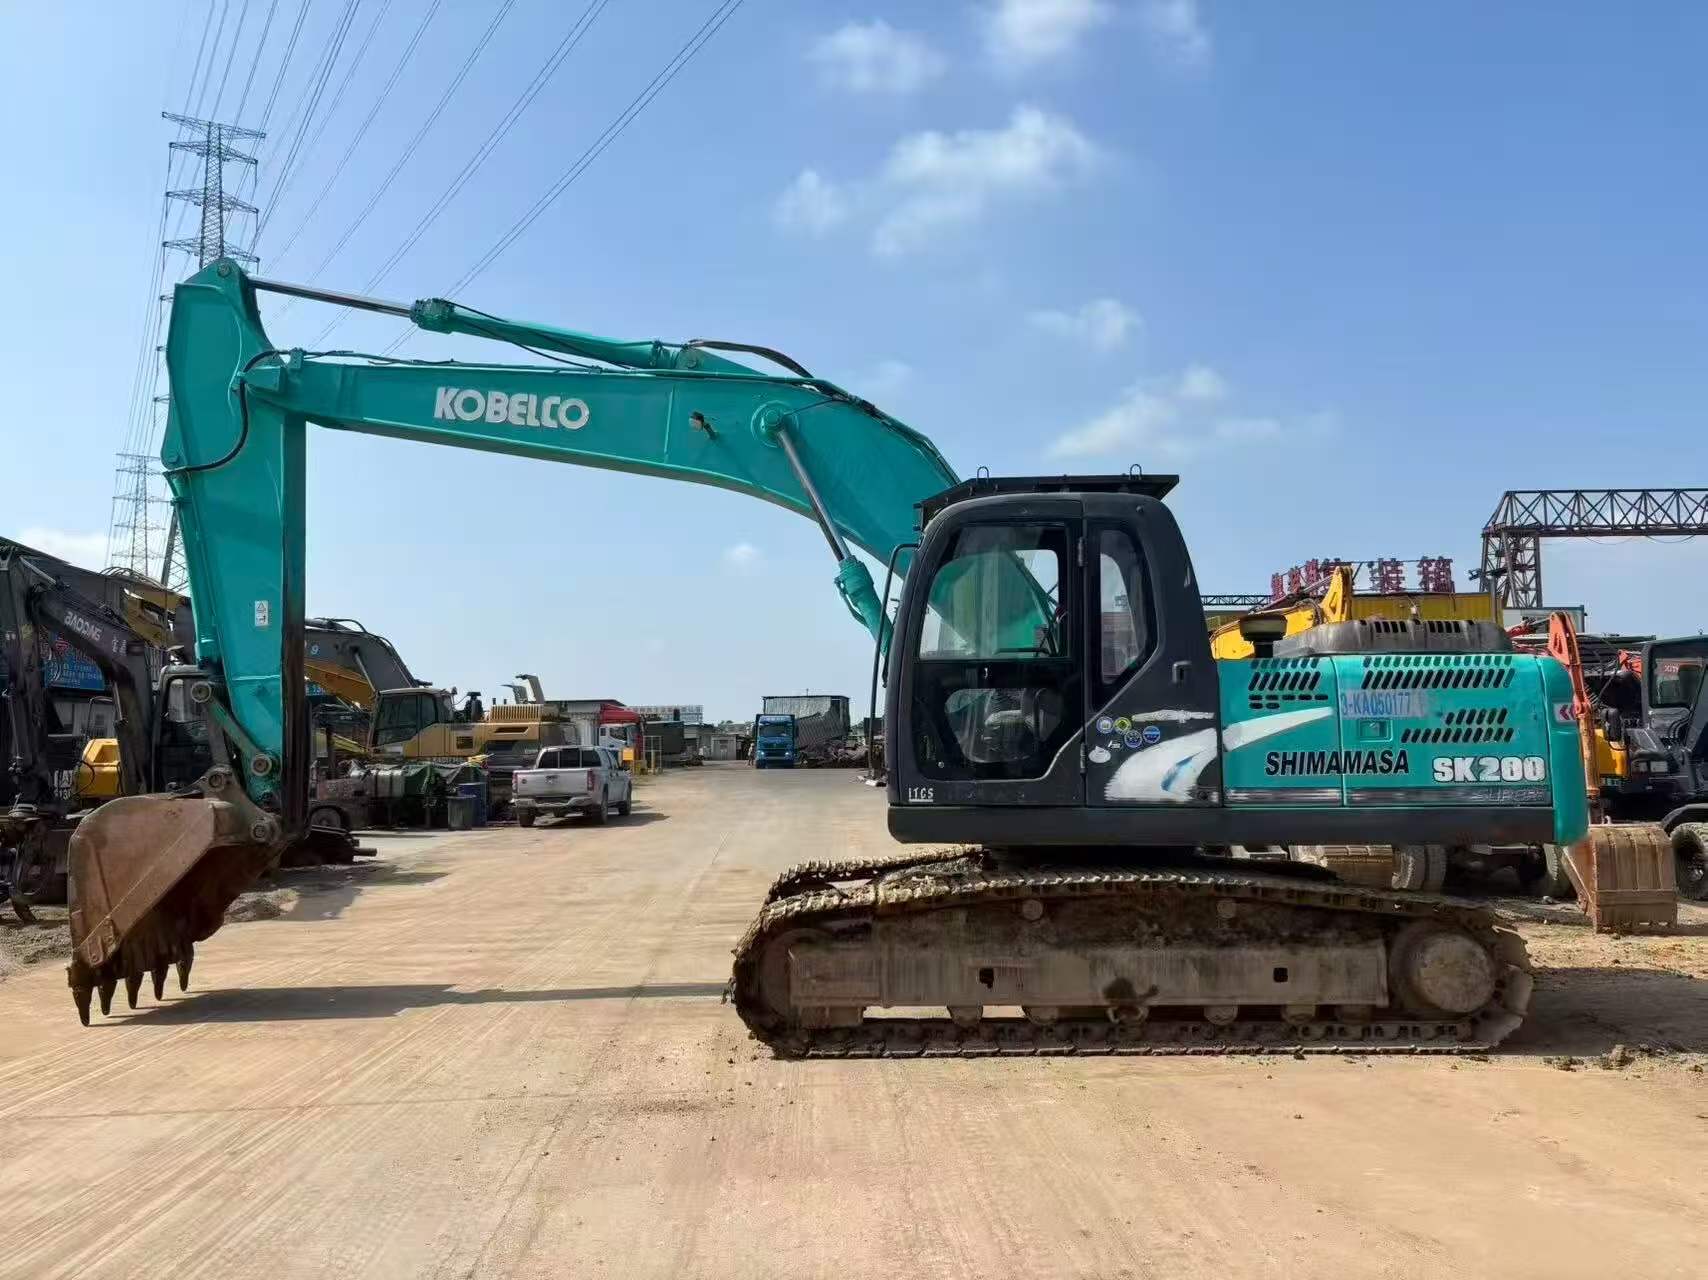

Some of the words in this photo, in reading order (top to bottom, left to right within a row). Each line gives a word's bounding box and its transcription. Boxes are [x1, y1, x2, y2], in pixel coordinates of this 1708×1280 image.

[433, 386, 590, 430] KOBELCO
[1265, 751, 1409, 776] SHIMAMASA
[1432, 756, 1547, 783] SK200
